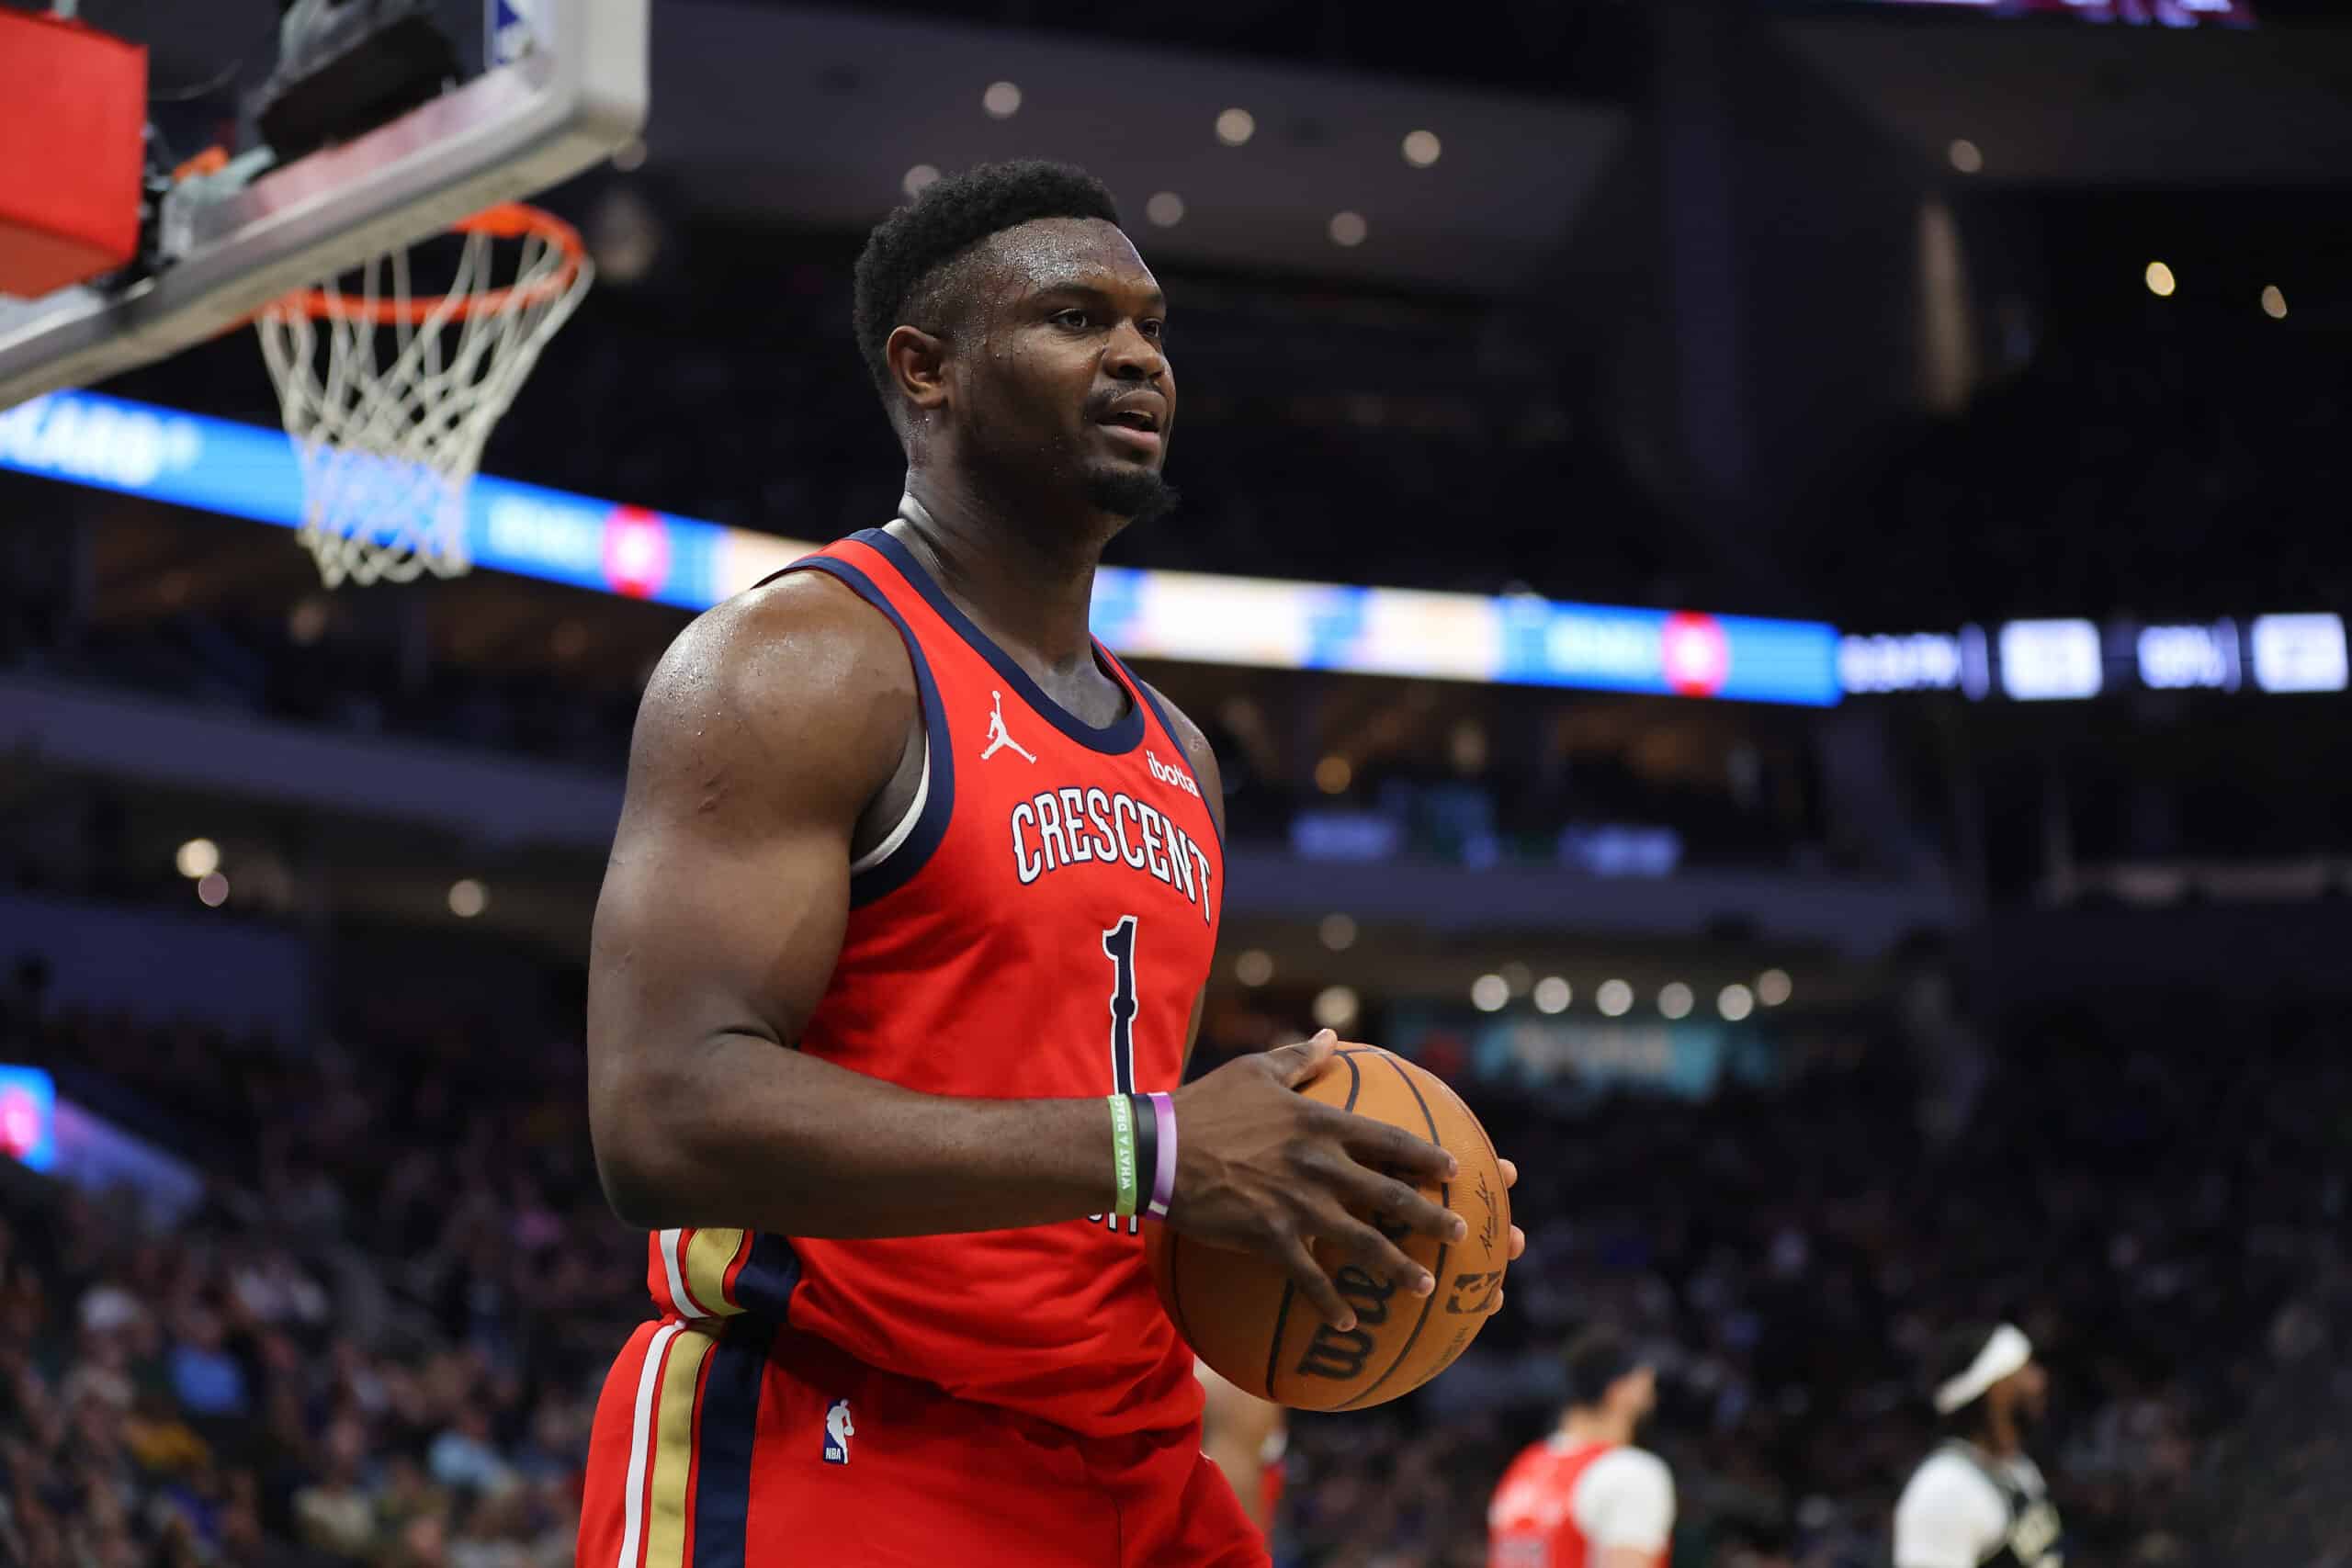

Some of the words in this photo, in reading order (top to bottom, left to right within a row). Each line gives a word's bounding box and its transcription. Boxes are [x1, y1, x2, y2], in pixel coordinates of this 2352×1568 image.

[1146, 750, 1200, 798] ibotta
[1012, 786, 1212, 927] CRESCENT
[1102, 915, 1138, 1095] 1
[1117, 1134, 1130, 1146] A
[1119, 1147, 1132, 1190] WHAT
[825, 1447, 842, 1461] NBA
